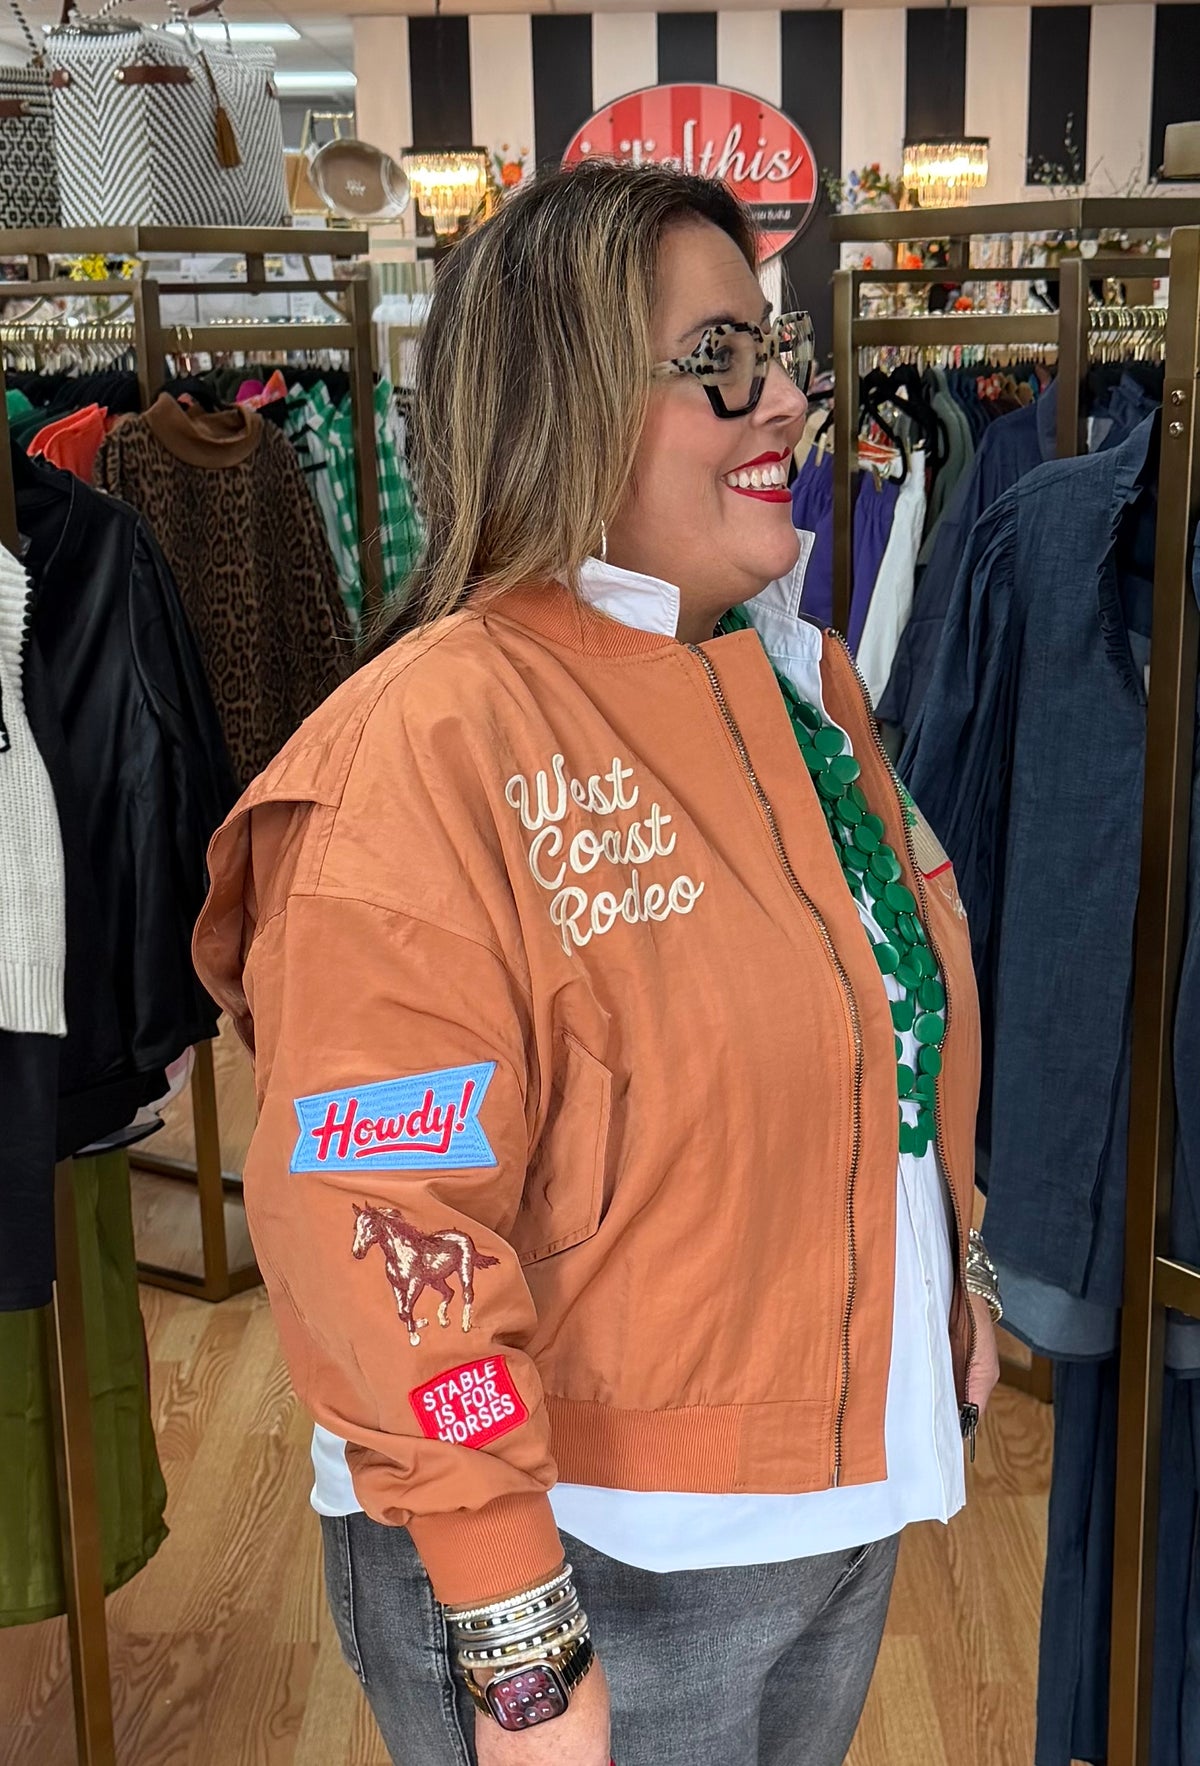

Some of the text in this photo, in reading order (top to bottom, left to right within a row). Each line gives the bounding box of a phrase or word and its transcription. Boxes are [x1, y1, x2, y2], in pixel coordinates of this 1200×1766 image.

[505, 753, 639, 831] West
[529, 802, 677, 890] Coast
[550, 868, 705, 957] Rodeo
[311, 1079, 476, 1161] Howdy!
[422, 1361, 497, 1412] STABLE
[435, 1380, 500, 1429] IS FOR
[438, 1393, 516, 1444] HORSES
